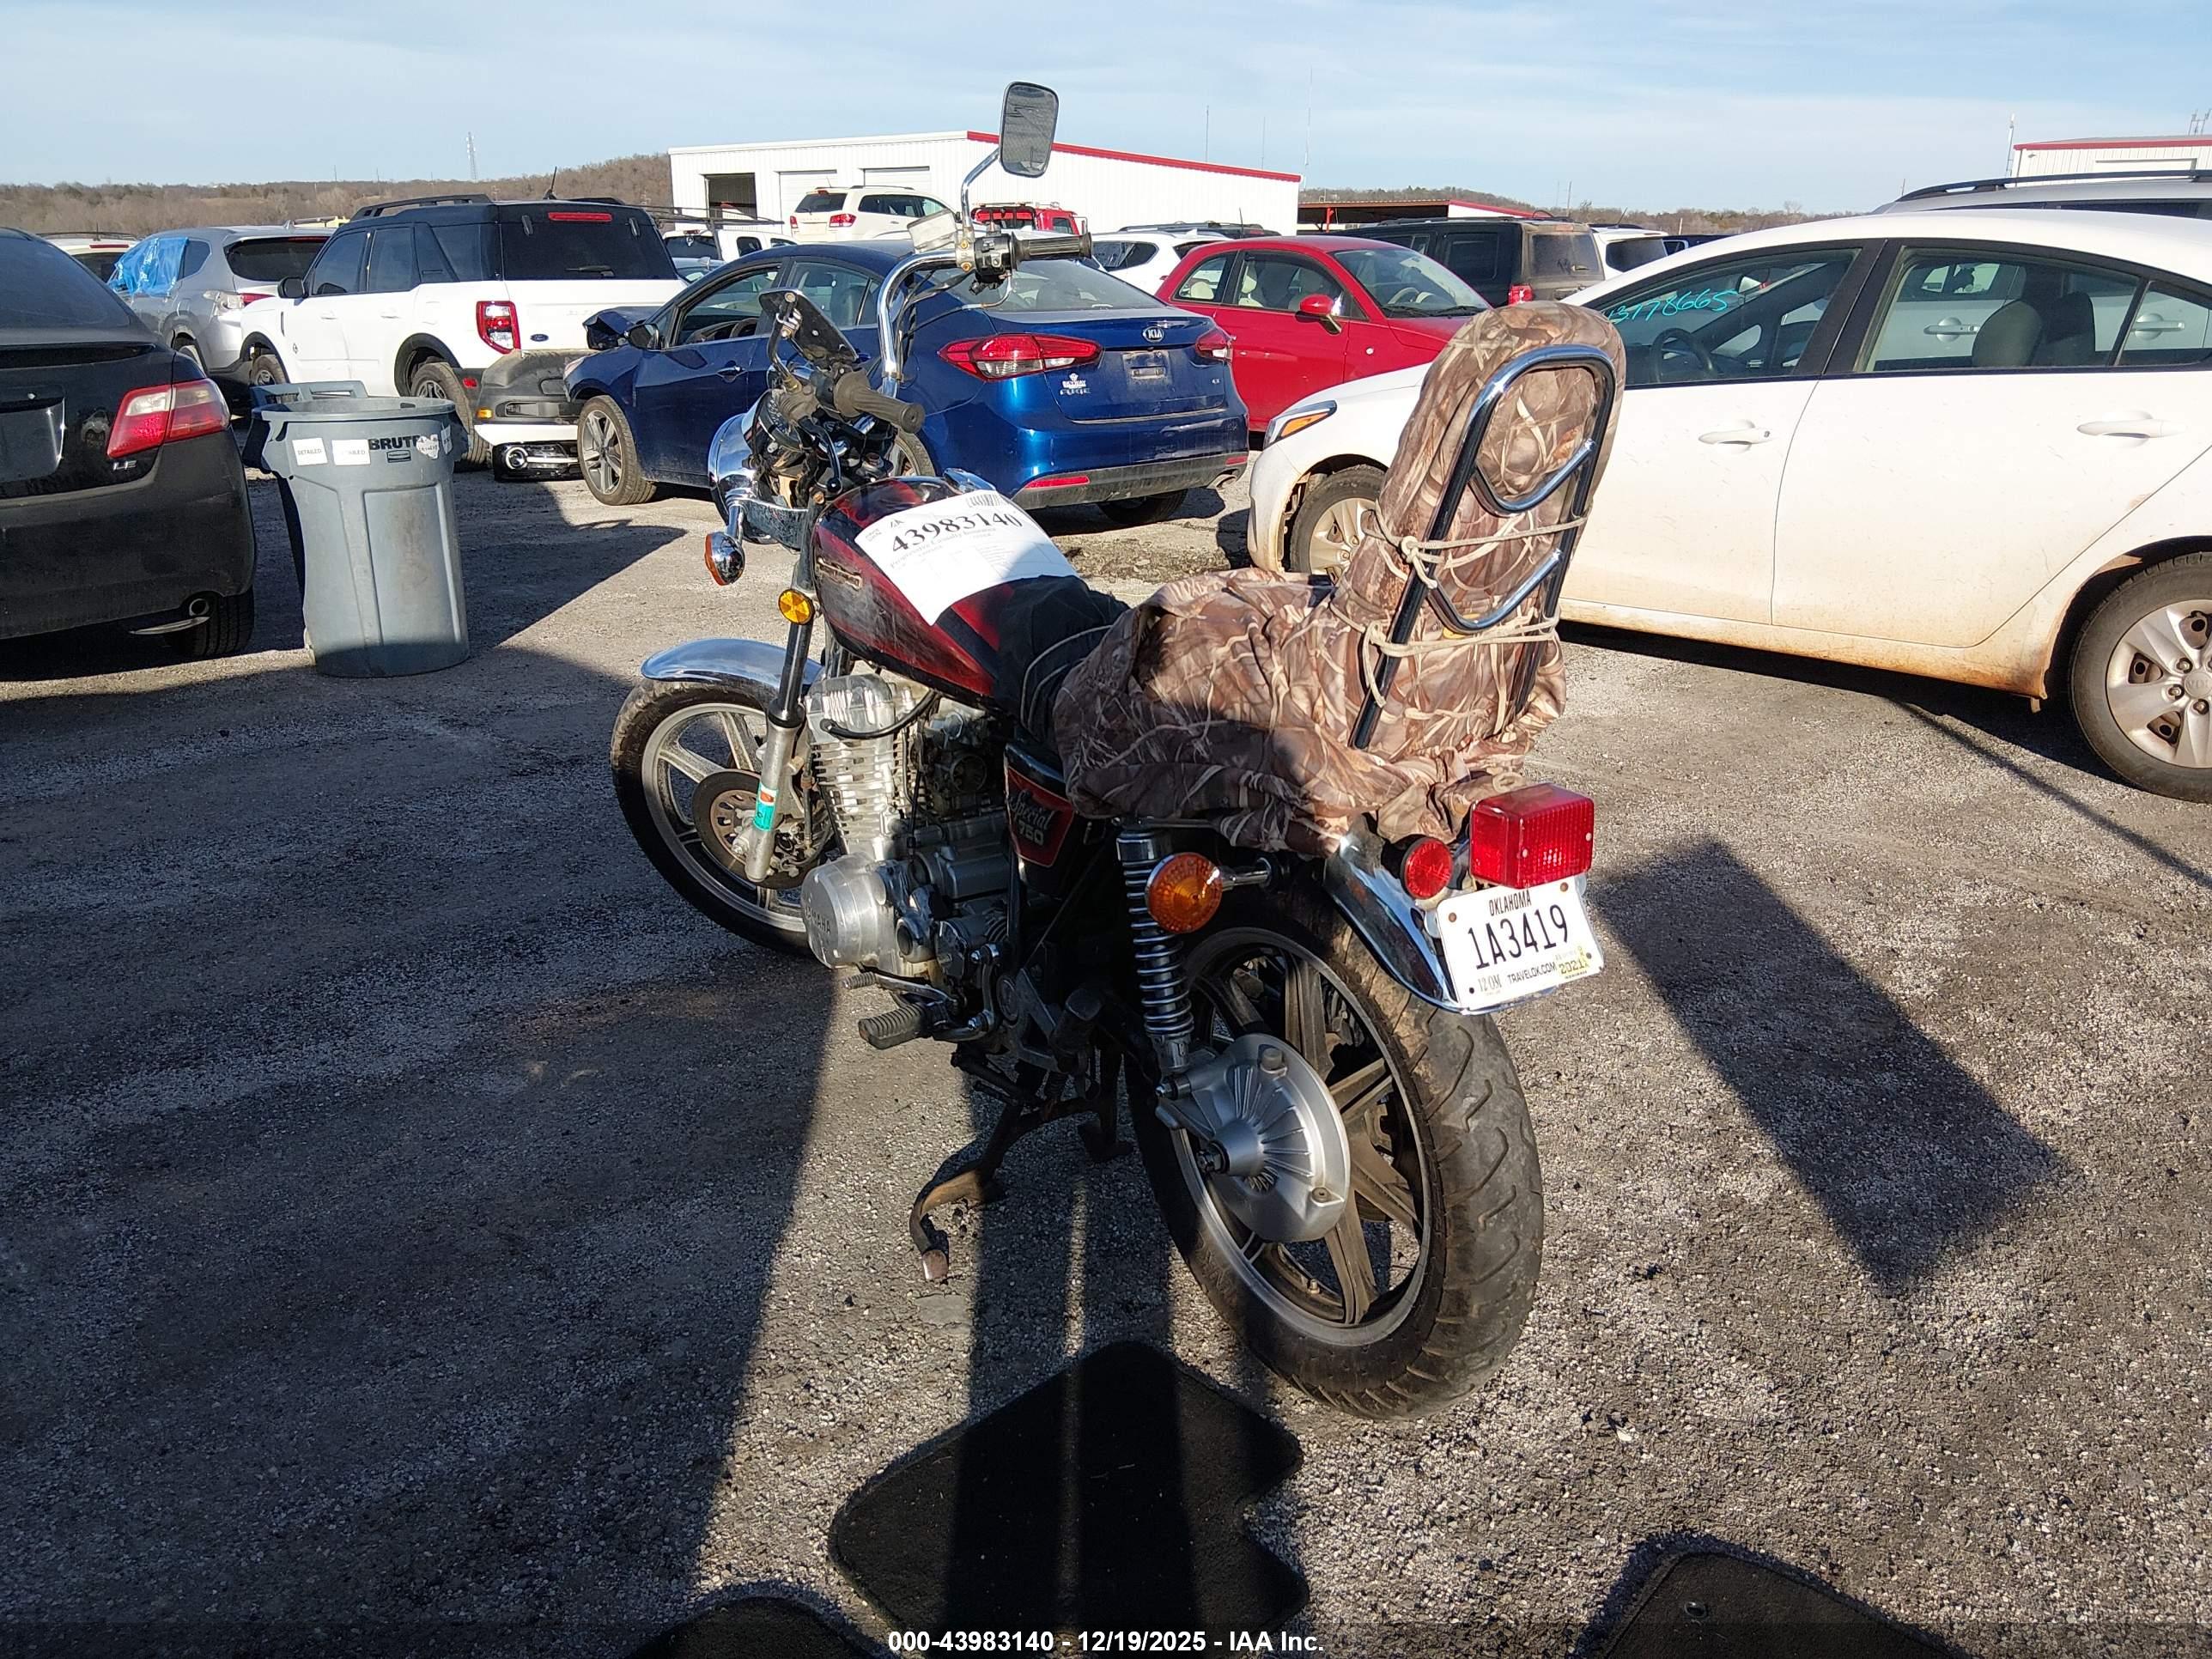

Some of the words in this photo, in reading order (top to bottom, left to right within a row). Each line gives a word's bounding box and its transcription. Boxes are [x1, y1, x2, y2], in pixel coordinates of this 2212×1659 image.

[1147, 329, 1164, 339] KIA
[112, 460, 137, 471] LE
[892, 513, 1023, 551] 43983140
[1009, 790, 1055, 830] Special
[1018, 818, 1044, 846] 750
[1488, 890, 1532, 916] OKLAHOMA
[1468, 904, 1568, 969] 1A3419
[1507, 961, 1558, 984] TRAVELOK.COM
[1559, 958, 1586, 975] 2021
